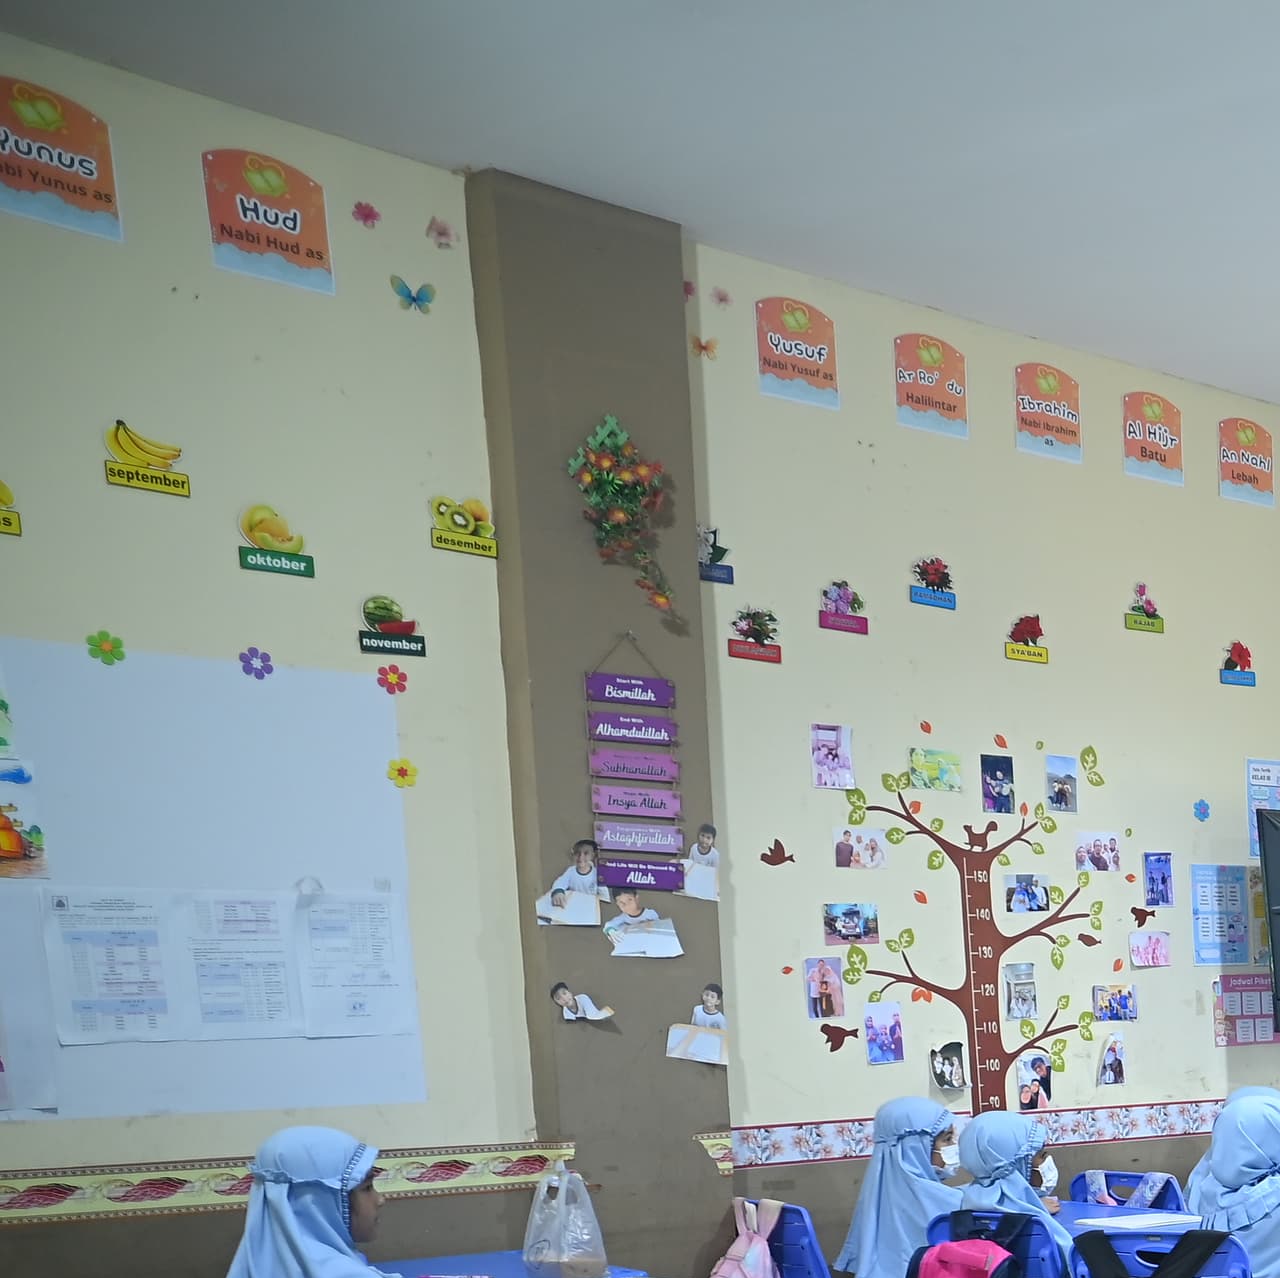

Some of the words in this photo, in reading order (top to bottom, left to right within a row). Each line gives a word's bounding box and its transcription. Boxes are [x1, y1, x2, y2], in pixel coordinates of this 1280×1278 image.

[0, 162, 23, 179] abi
[28, 168, 87, 197] Yunus
[92, 189, 113, 204] as
[237, 195, 299, 233] Hud
[220, 223, 261, 245] Nabi
[266, 234, 301, 256] Hud
[306, 247, 324, 261] as
[768, 333, 828, 363] Yusuf
[763, 357, 788, 371] Nabi
[790, 363, 821, 378] Yusuf
[822, 371, 834, 381] as
[897, 368, 914, 383] Ar
[947, 381, 964, 396] du
[906, 392, 957, 413] Halilintar
[1018, 396, 1079, 424] Ibrahim
[1020, 418, 1041, 430] Nabi
[1042, 422, 1077, 438] Ibrahim
[1126, 421, 1143, 439] Al
[1147, 424, 1178, 449] Hijr
[1044, 438, 1054, 447] as
[1140, 446, 1167, 463] Batu
[1221, 447, 1237, 463] An
[1241, 449, 1273, 472] Nahl
[107, 465, 188, 491] september
[1231, 468, 1259, 485] Lebah
[435, 533, 493, 553] desember
[246, 552, 307, 572] oktober
[361, 636, 424, 652] november
[605, 684, 656, 702] Bismillah
[596, 722, 670, 741] Alhamdulillah
[601, 760, 668, 777] Subhanallah
[608, 794, 637, 810] Insya
[640, 797, 667, 809] Allah
[603, 830, 676, 847] Astaghfirullah
[626, 871, 656, 885] Allah
[973, 870, 988, 883] 150
[975, 908, 991, 921] 140
[978, 946, 993, 959] 130
[981, 983, 995, 996] 120
[1229, 976, 1254, 987] Jadwal
[983, 1021, 998, 1034] 110
[986, 1058, 1000, 1072] 100
[989, 1095, 1000, 1109] 90
